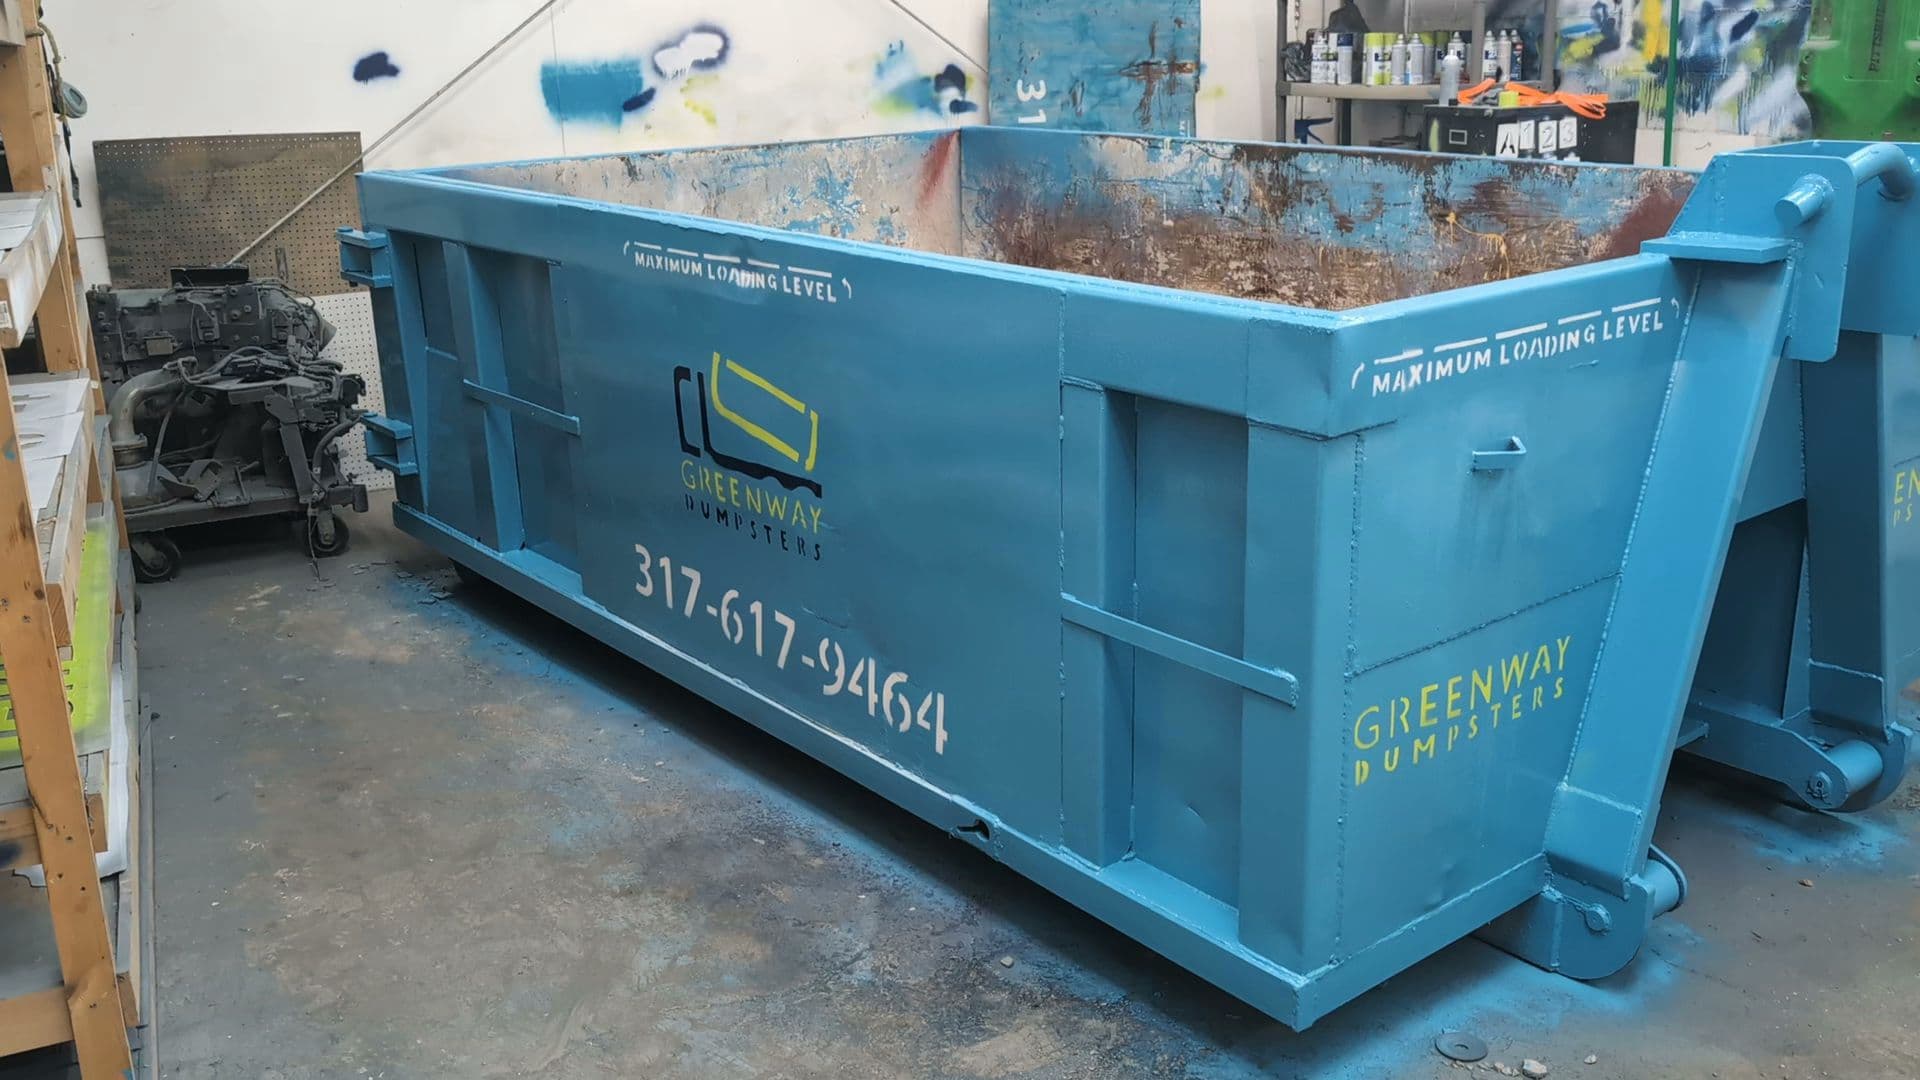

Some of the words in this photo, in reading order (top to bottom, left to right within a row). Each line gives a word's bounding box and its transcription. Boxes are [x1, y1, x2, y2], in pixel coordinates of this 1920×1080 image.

[635, 252, 702, 277] MAXIMUM
[707, 262, 778, 291] LOADING
[783, 275, 837, 303] LEVEL
[1372, 348, 1492, 397] MAXIMUM
[1499, 324, 1596, 365] LOADING
[1602, 310, 1664, 341] LEVEL
[680, 459, 823, 535] GREENWAY
[684, 493, 822, 562] DUMPSTERS
[634, 543, 949, 756] 317-617-9464
[1354, 635, 1571, 749] GREENWAY
[1354, 676, 1564, 787] DUMPSTERS
